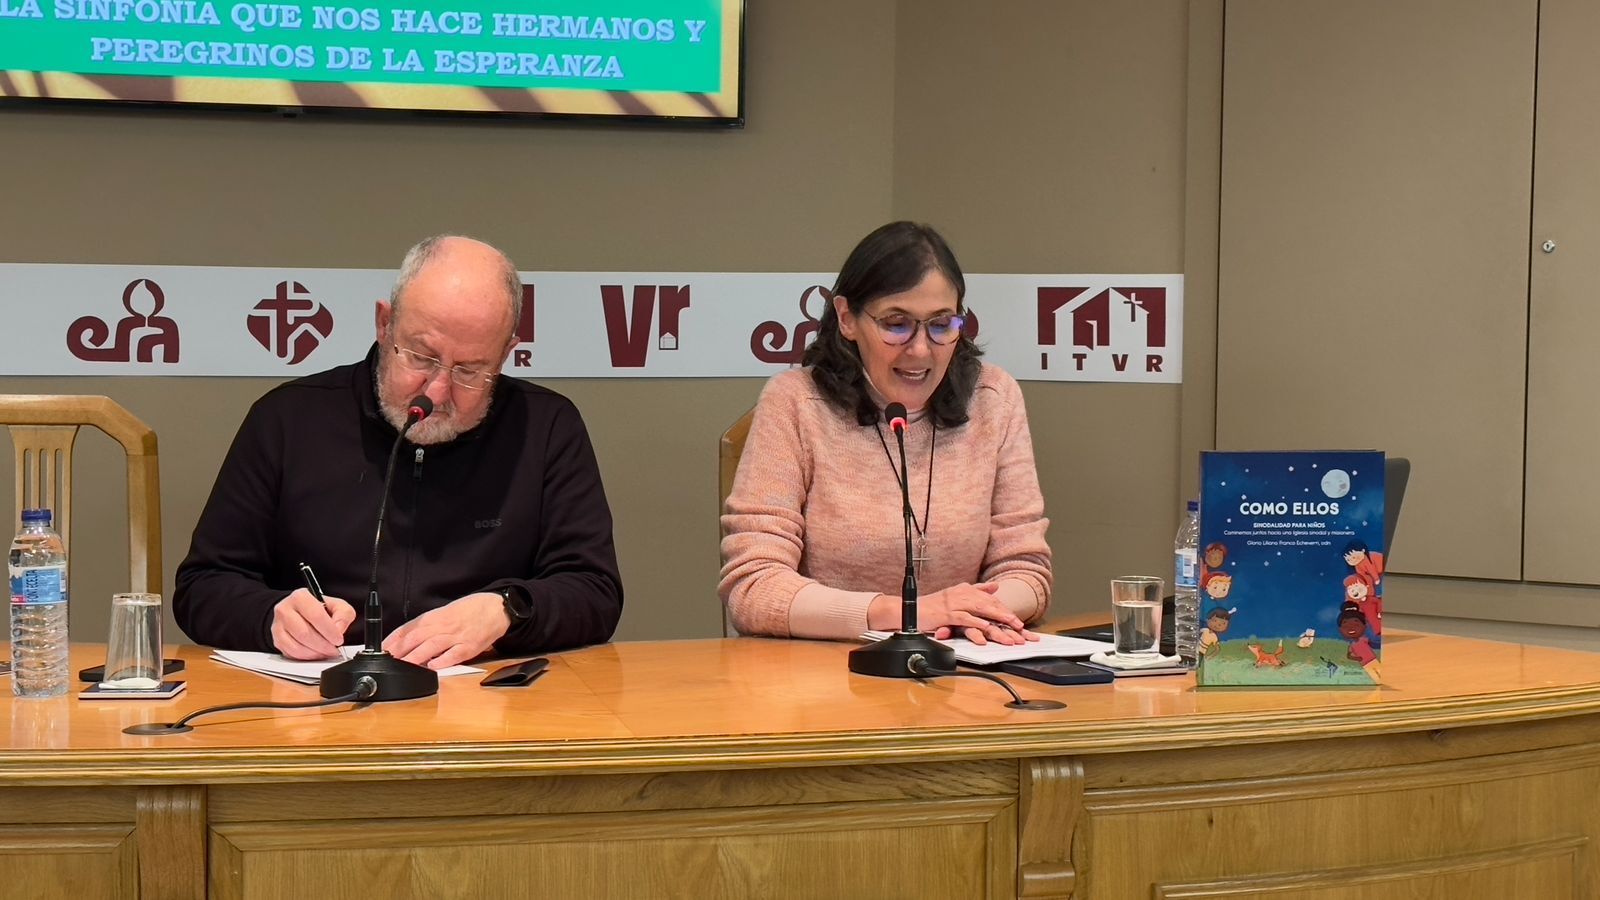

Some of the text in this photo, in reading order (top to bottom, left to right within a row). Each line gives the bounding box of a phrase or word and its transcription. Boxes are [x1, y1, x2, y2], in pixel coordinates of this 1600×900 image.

[0, 0, 44, 18] LA
[231, 3, 302, 32] QUE
[312, 6, 381, 31] NOS
[391, 9, 482, 35] HACE
[492, 13, 675, 42] HERMANOS
[684, 19, 706, 42] Y
[91, 37, 625, 79] PEREGRINOS DE LA ESPERANZA
[1239, 502, 1340, 515] COMO ELLOS
[474, 519, 502, 529] BOSS
